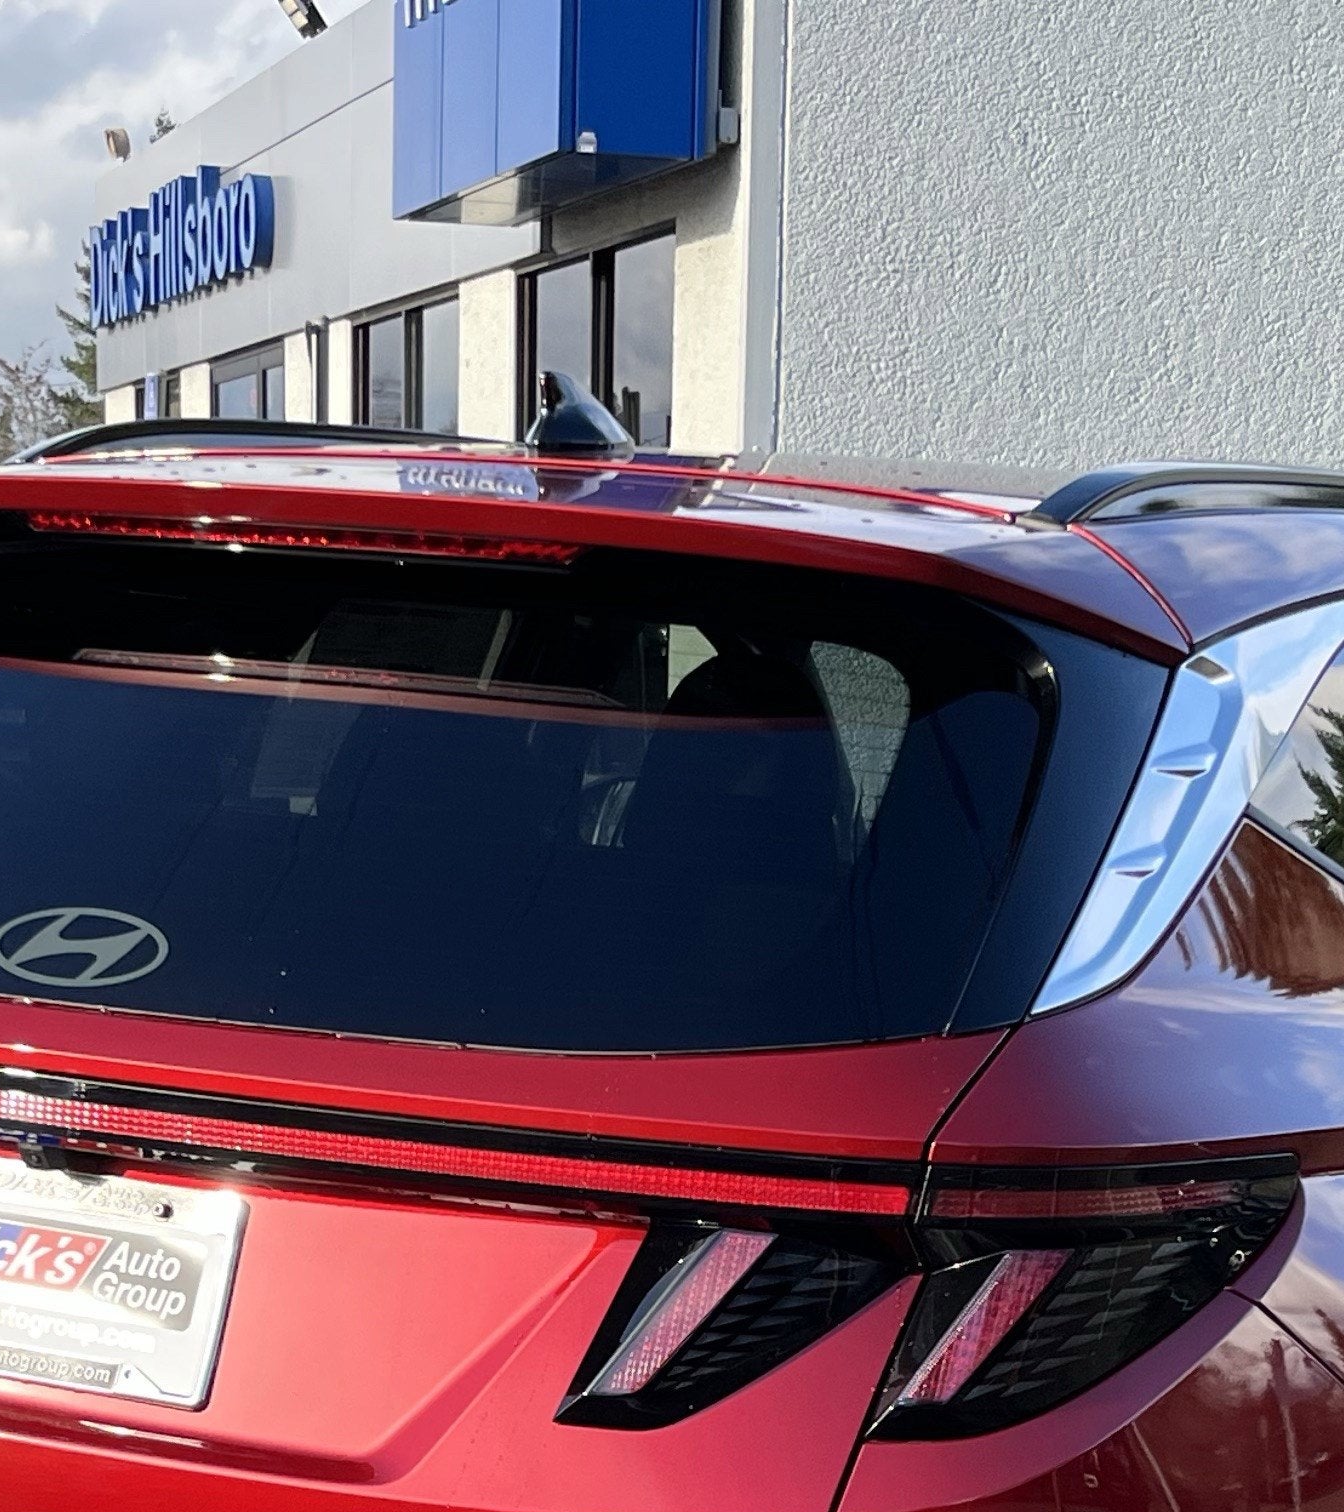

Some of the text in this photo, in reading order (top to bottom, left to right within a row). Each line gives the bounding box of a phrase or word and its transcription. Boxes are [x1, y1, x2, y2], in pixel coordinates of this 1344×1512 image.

[90, 165, 264, 329] Dick's Hillsboro
[102, 1242, 181, 1283] Auto
[93, 1271, 188, 1320] Group
